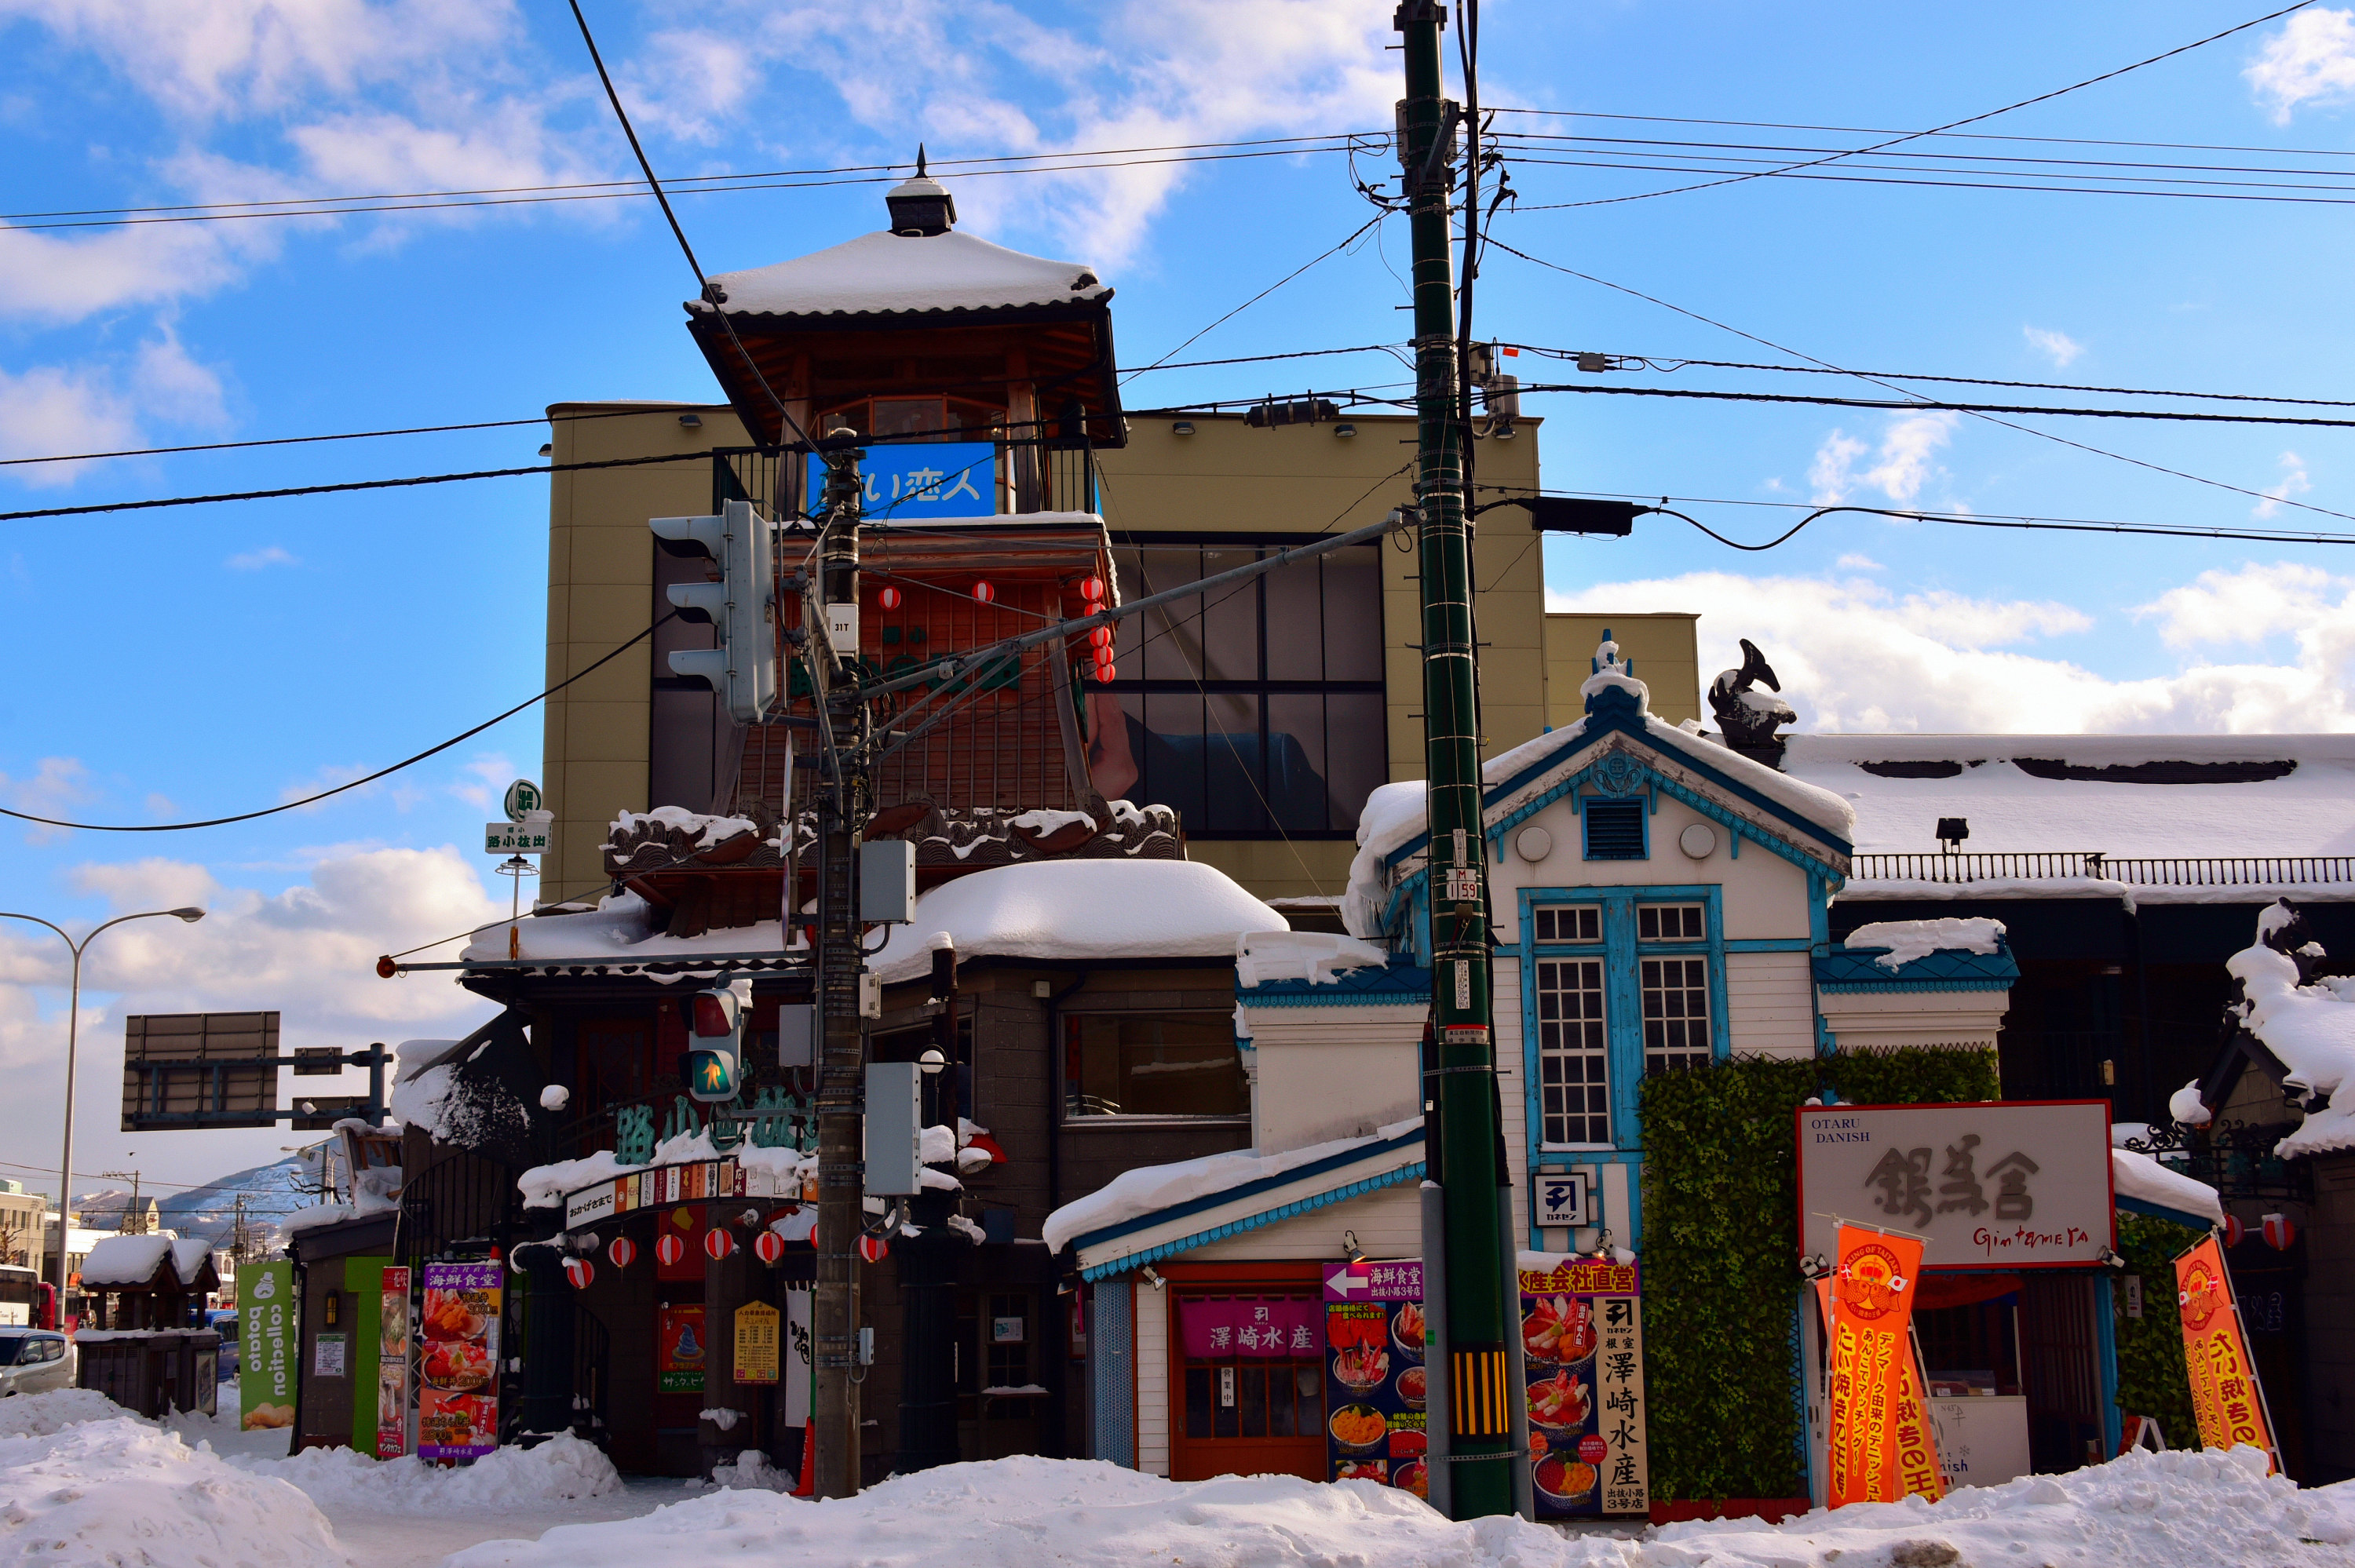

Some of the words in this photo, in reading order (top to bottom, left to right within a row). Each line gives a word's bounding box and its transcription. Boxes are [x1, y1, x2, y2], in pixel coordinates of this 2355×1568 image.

[834, 623, 849, 632] 31T
[1458, 870, 1466, 879] M
[1811, 1118, 1860, 1129] OTARU
[1816, 1132, 1870, 1143] DANISH
[569, 1194, 612, 1218] おかげさまで
[1846, 1249, 1865, 1264] KING
[1877, 1247, 1900, 1274] TAIYAKI
[429, 1274, 497, 1287] 海鮮食堂
[1371, 1266, 1422, 1285] 海鮮食堂
[1210, 1325, 1313, 1350] 澤崎水産
[1605, 1337, 1635, 1350] 根室
[1222, 1369, 1232, 1402] 営業中
[1605, 1351, 1641, 1486] 澤崎水産
[1608, 1488, 1645, 1498] 出抜小路
[1608, 1498, 1644, 1509] 3号店
